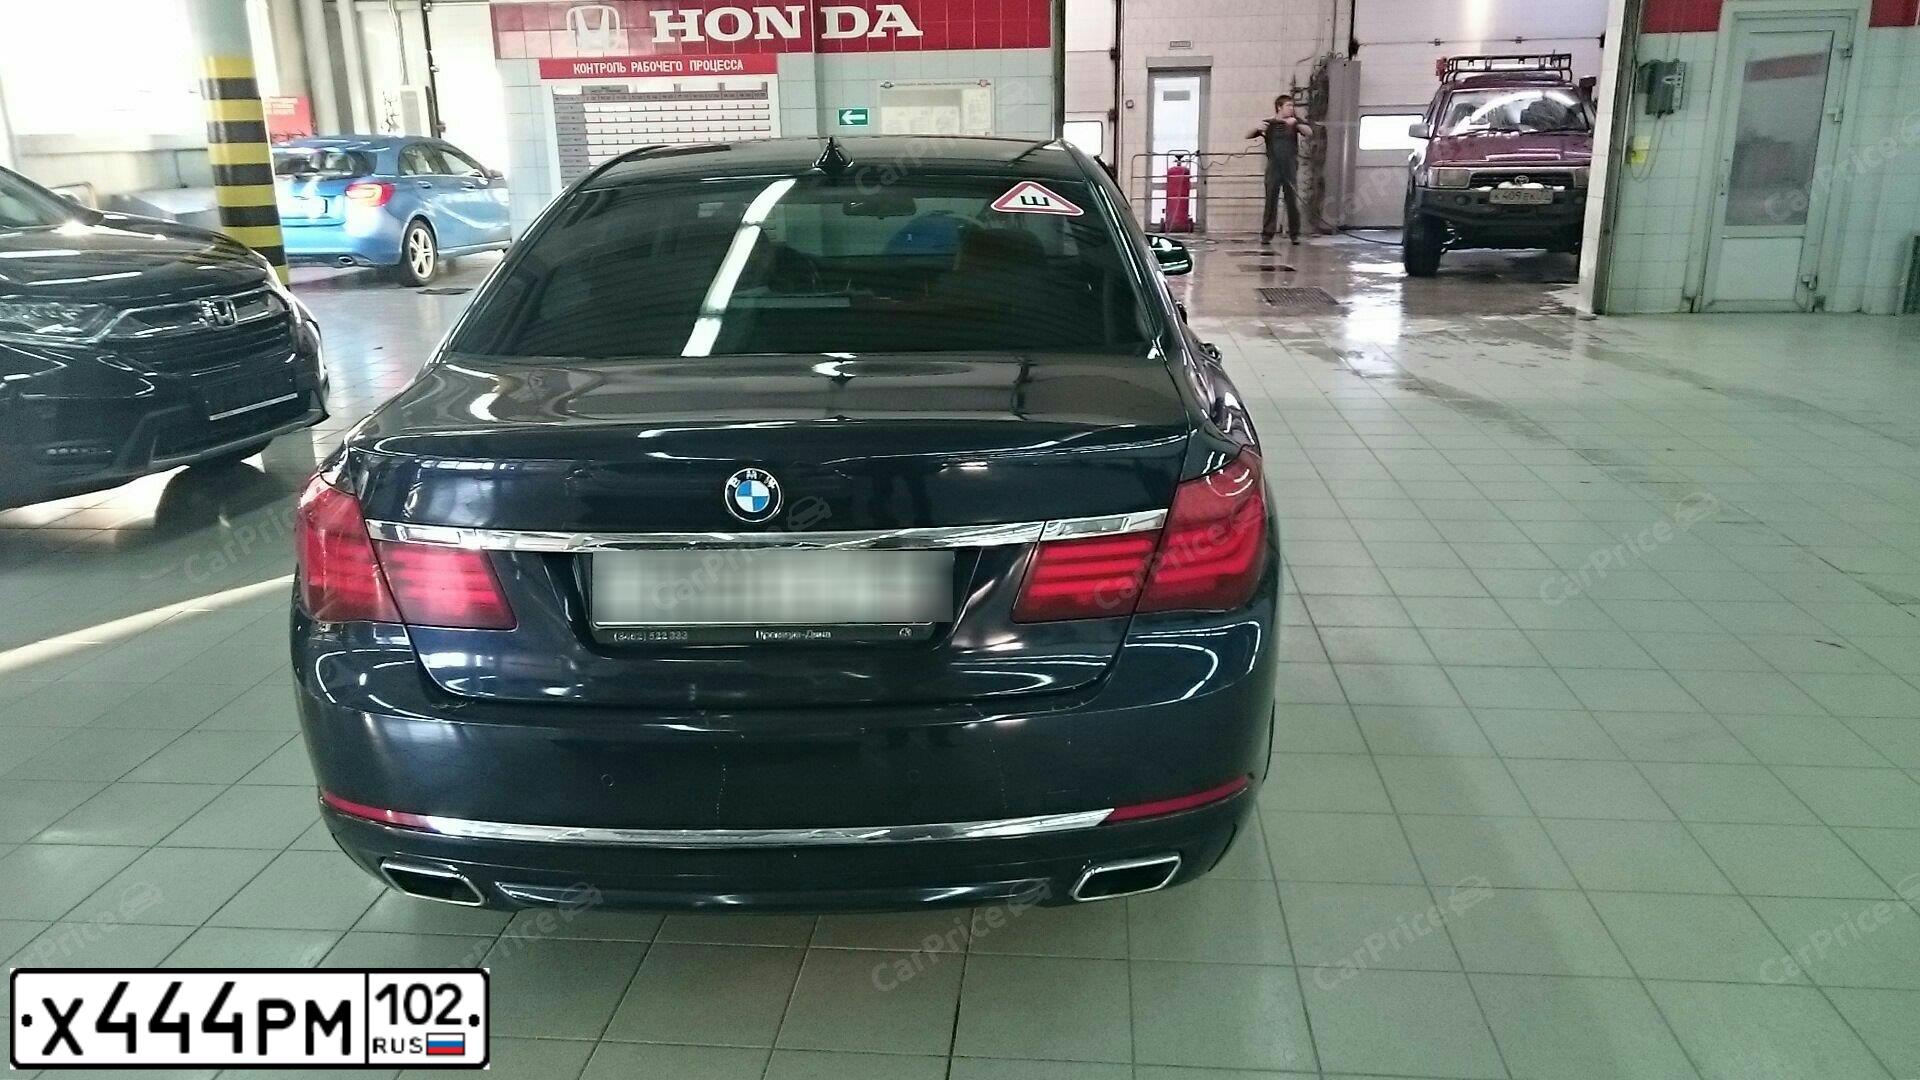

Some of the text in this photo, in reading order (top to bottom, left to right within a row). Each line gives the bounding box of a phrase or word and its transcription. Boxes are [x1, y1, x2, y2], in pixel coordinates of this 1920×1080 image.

[573, 59, 744, 75] КОНТРОЛЬ РАБОЧЕГО ПРОЦЕССА
[729, 469, 776, 489] BMW
